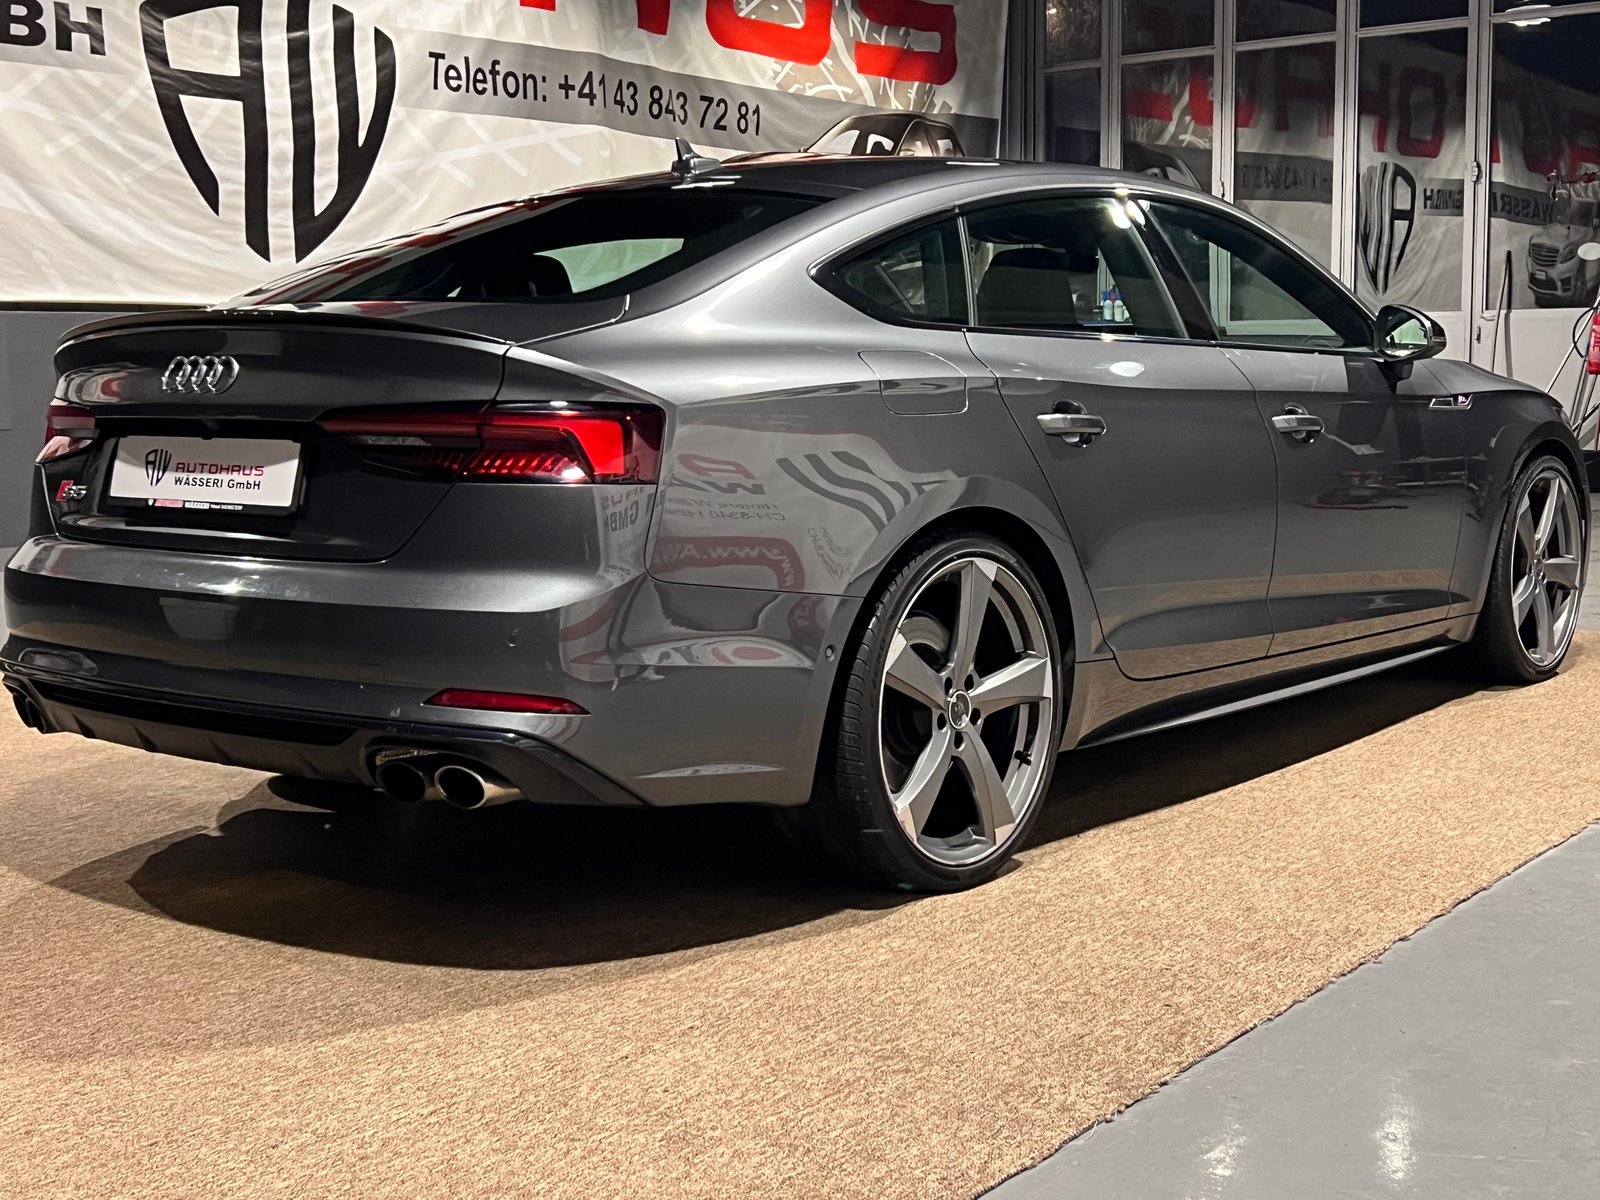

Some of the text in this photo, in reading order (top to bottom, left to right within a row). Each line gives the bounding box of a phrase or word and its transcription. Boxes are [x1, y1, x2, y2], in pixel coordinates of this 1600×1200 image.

[428, 51, 762, 137] Telefon: +41 43 843 72 81
[175, 462, 265, 477] AUTOHAUS
[227, 479, 261, 491] GmbH
